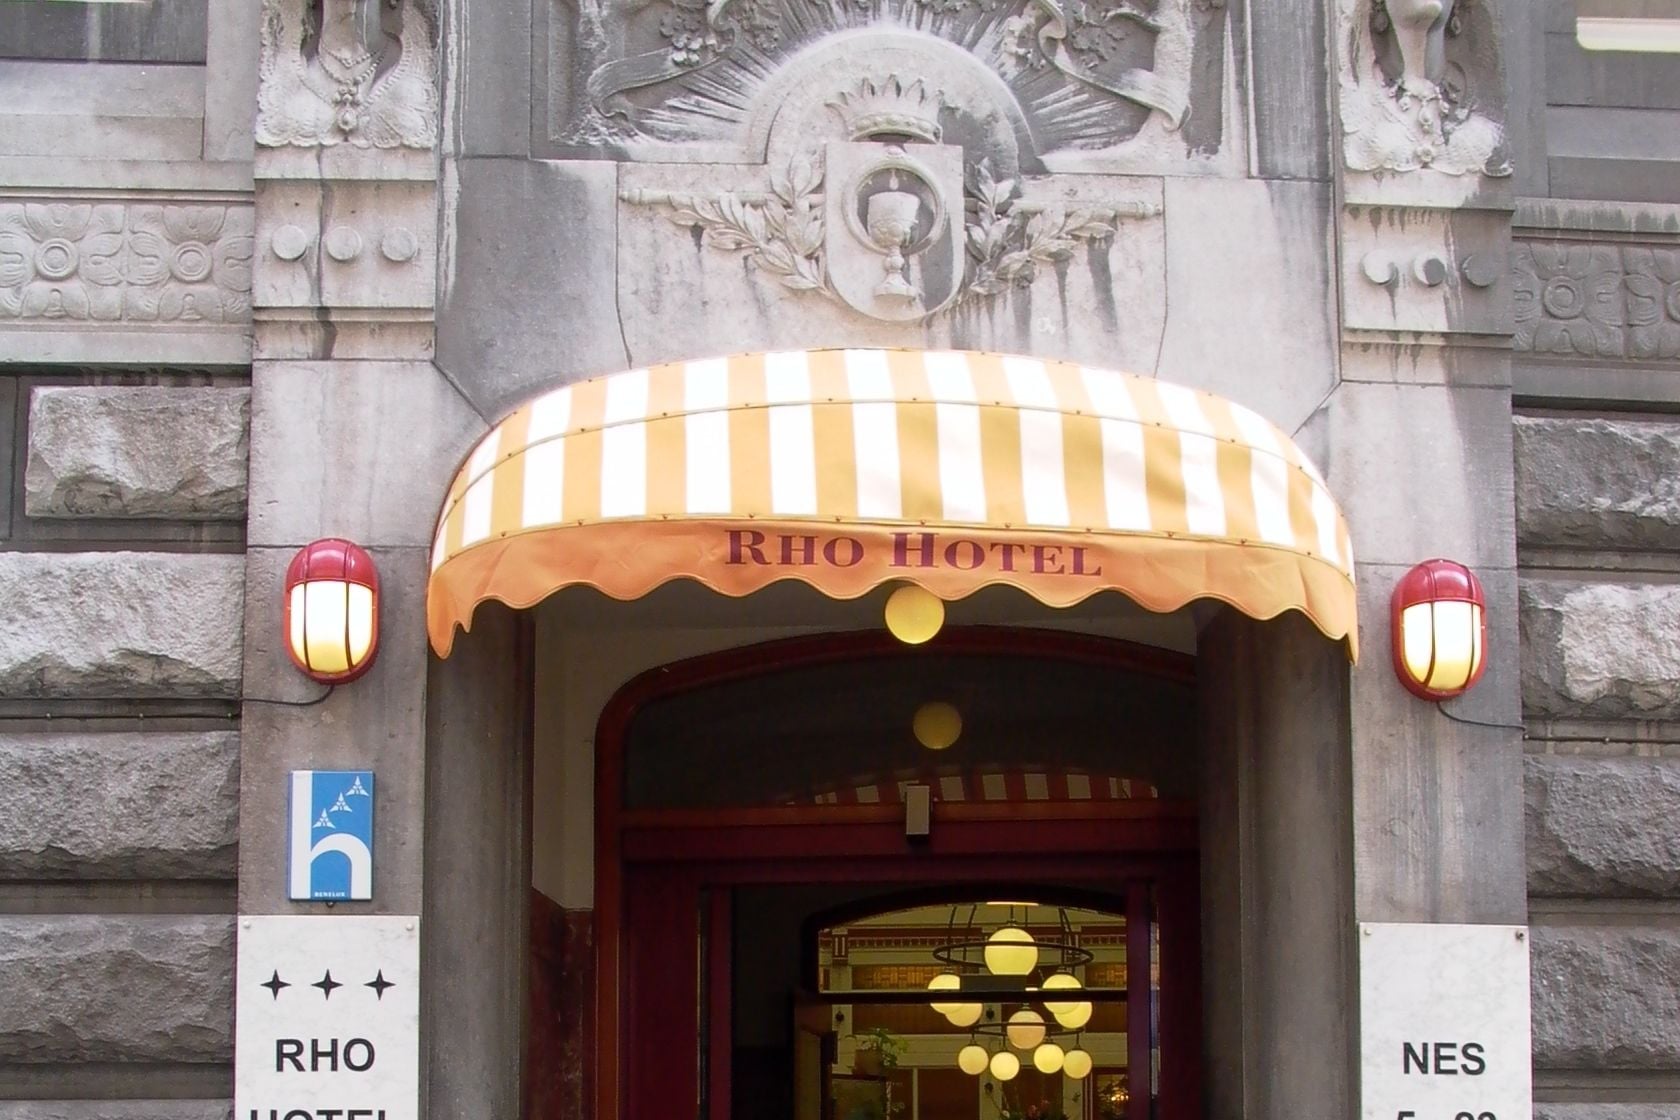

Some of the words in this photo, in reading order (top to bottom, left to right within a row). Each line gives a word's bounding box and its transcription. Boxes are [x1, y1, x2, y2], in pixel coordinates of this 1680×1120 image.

[724, 529, 865, 568] RHO
[889, 531, 1103, 577] HOTEL
[276, 1037, 376, 1073] RHO
[1402, 1042, 1486, 1076] NES
